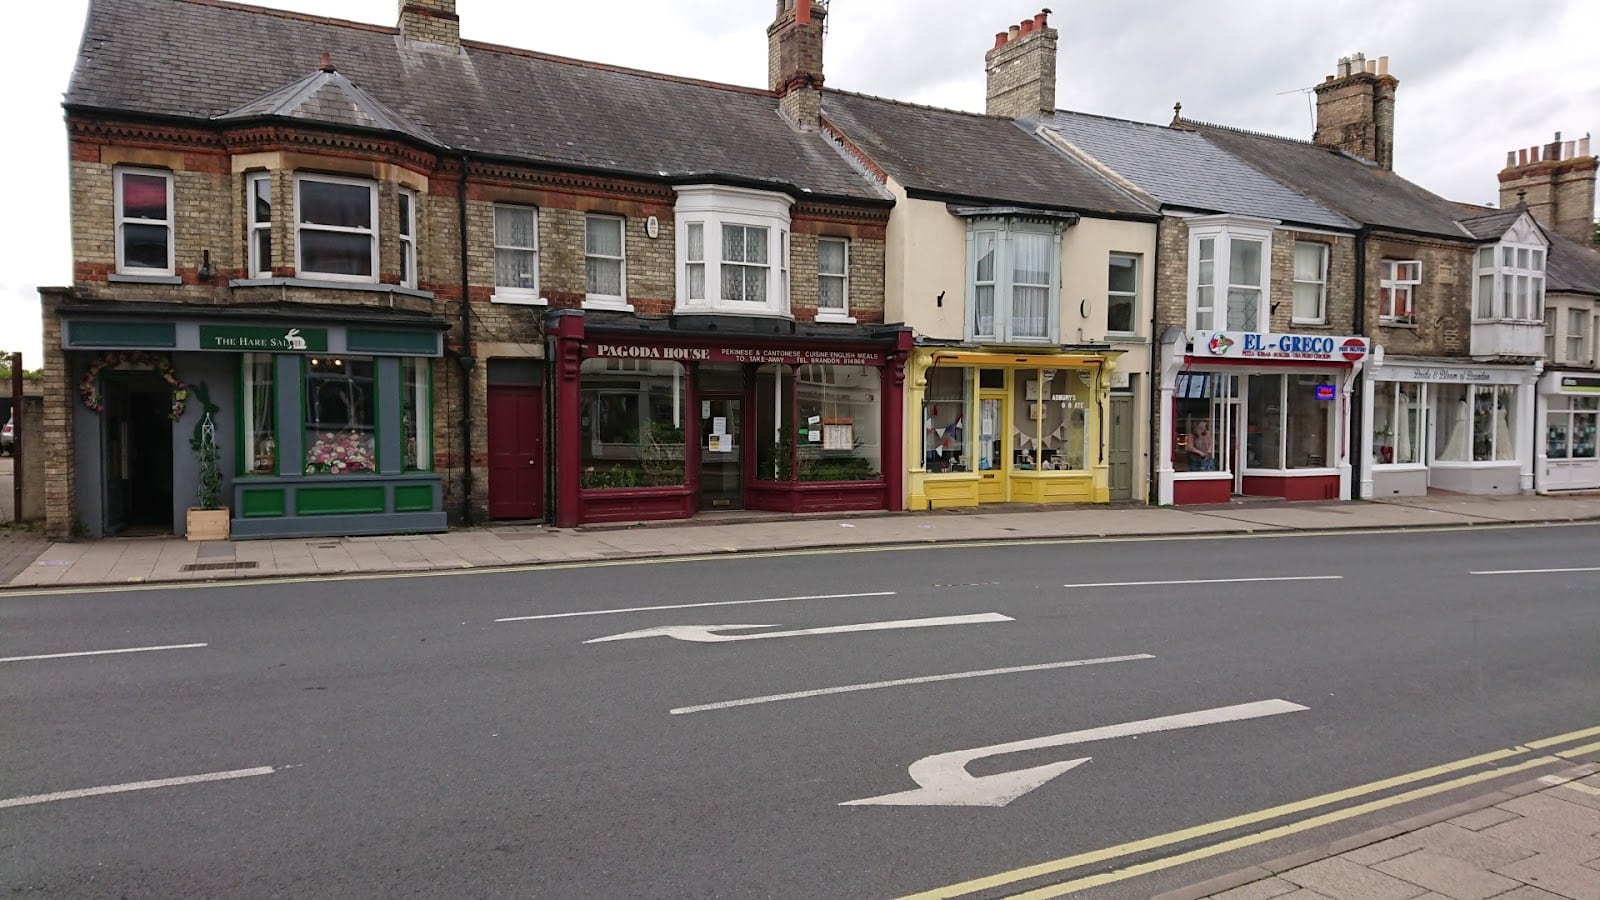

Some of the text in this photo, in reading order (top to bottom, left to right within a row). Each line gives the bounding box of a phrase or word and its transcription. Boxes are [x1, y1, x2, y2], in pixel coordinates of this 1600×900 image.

[215, 337, 236, 346] THE
[240, 337, 267, 346] HARE
[597, 344, 710, 360] PAGODA HOUSE
[721, 348, 753, 356] PEKINESE
[856, 352, 879, 360] MEALS
[811, 357, 841, 365] BRANDON
